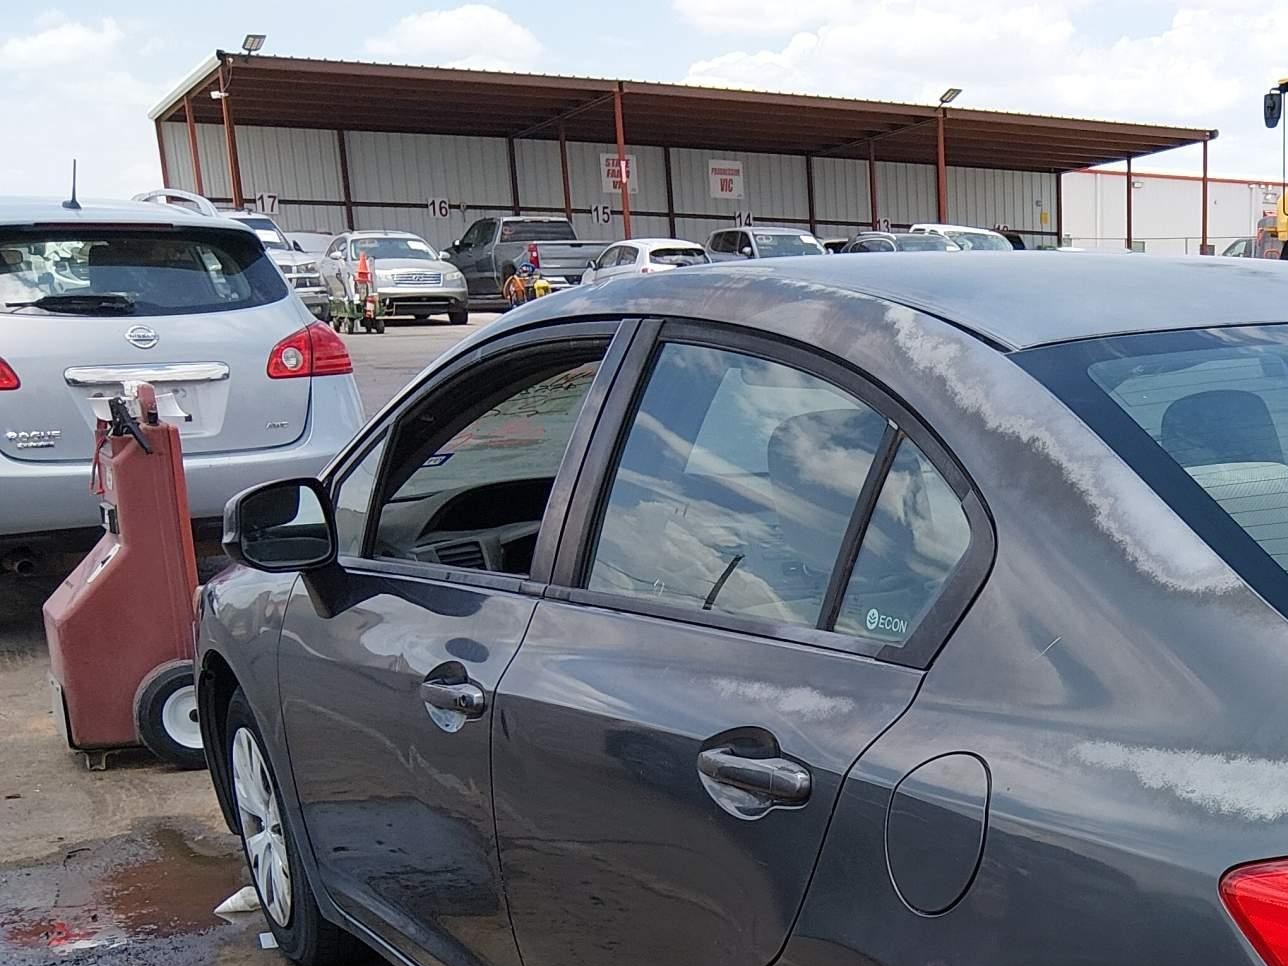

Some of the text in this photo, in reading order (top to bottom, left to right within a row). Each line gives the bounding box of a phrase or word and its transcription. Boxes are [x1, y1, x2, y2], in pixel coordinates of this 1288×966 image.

[605, 158, 630, 168] STAE
[719, 178, 734, 192] VIC
[257, 194, 277, 213] 17
[428, 199, 449, 217] 16
[592, 205, 610, 224] 15
[736, 211, 752, 227] 14
[878, 615, 908, 633] ECON
